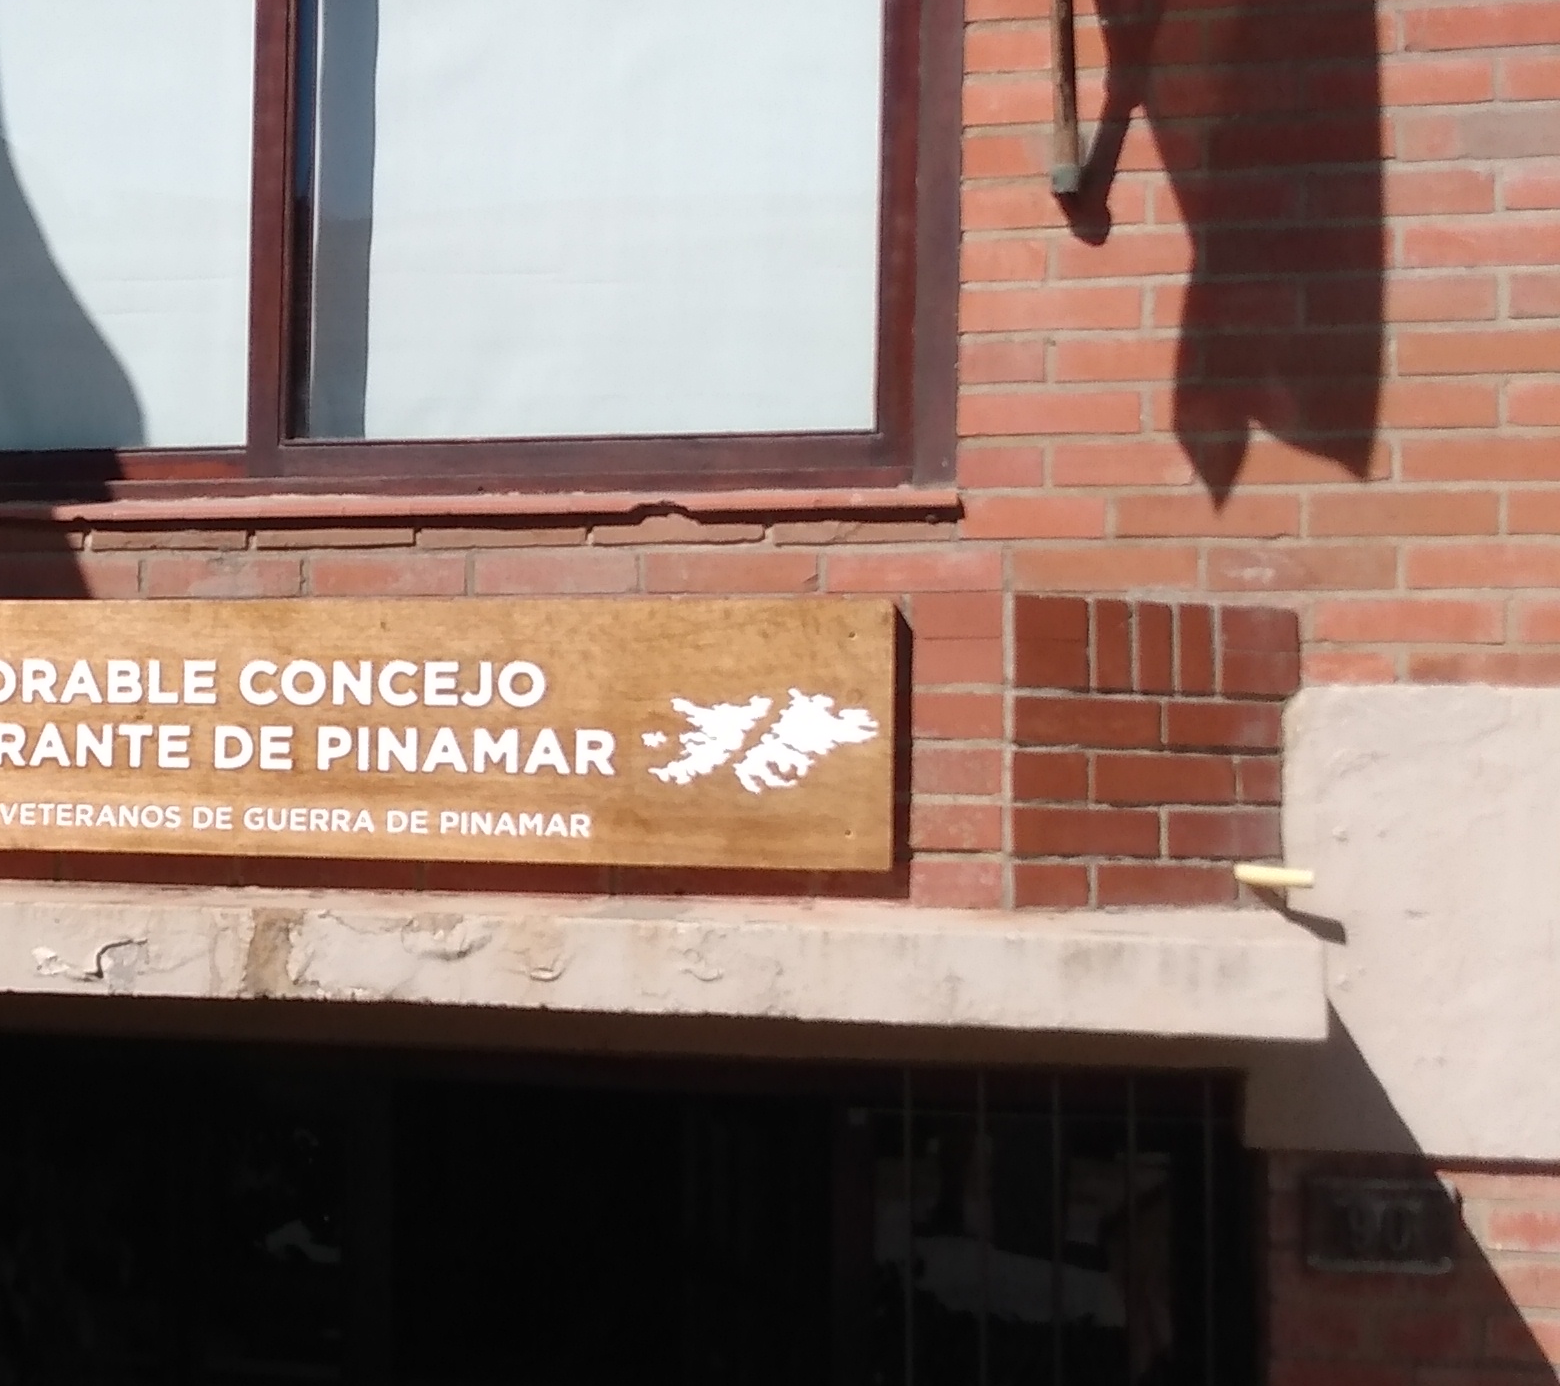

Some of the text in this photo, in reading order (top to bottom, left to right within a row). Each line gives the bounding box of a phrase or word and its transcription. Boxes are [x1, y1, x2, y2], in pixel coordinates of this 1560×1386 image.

[238, 658, 547, 708] CONCEJO
[213, 724, 294, 771] DE
[316, 725, 616, 776] PINAMAR
[191, 805, 234, 831] DE
[242, 806, 376, 834] GUERRA
[385, 809, 429, 835] DE
[439, 810, 592, 839] PINAMAR
